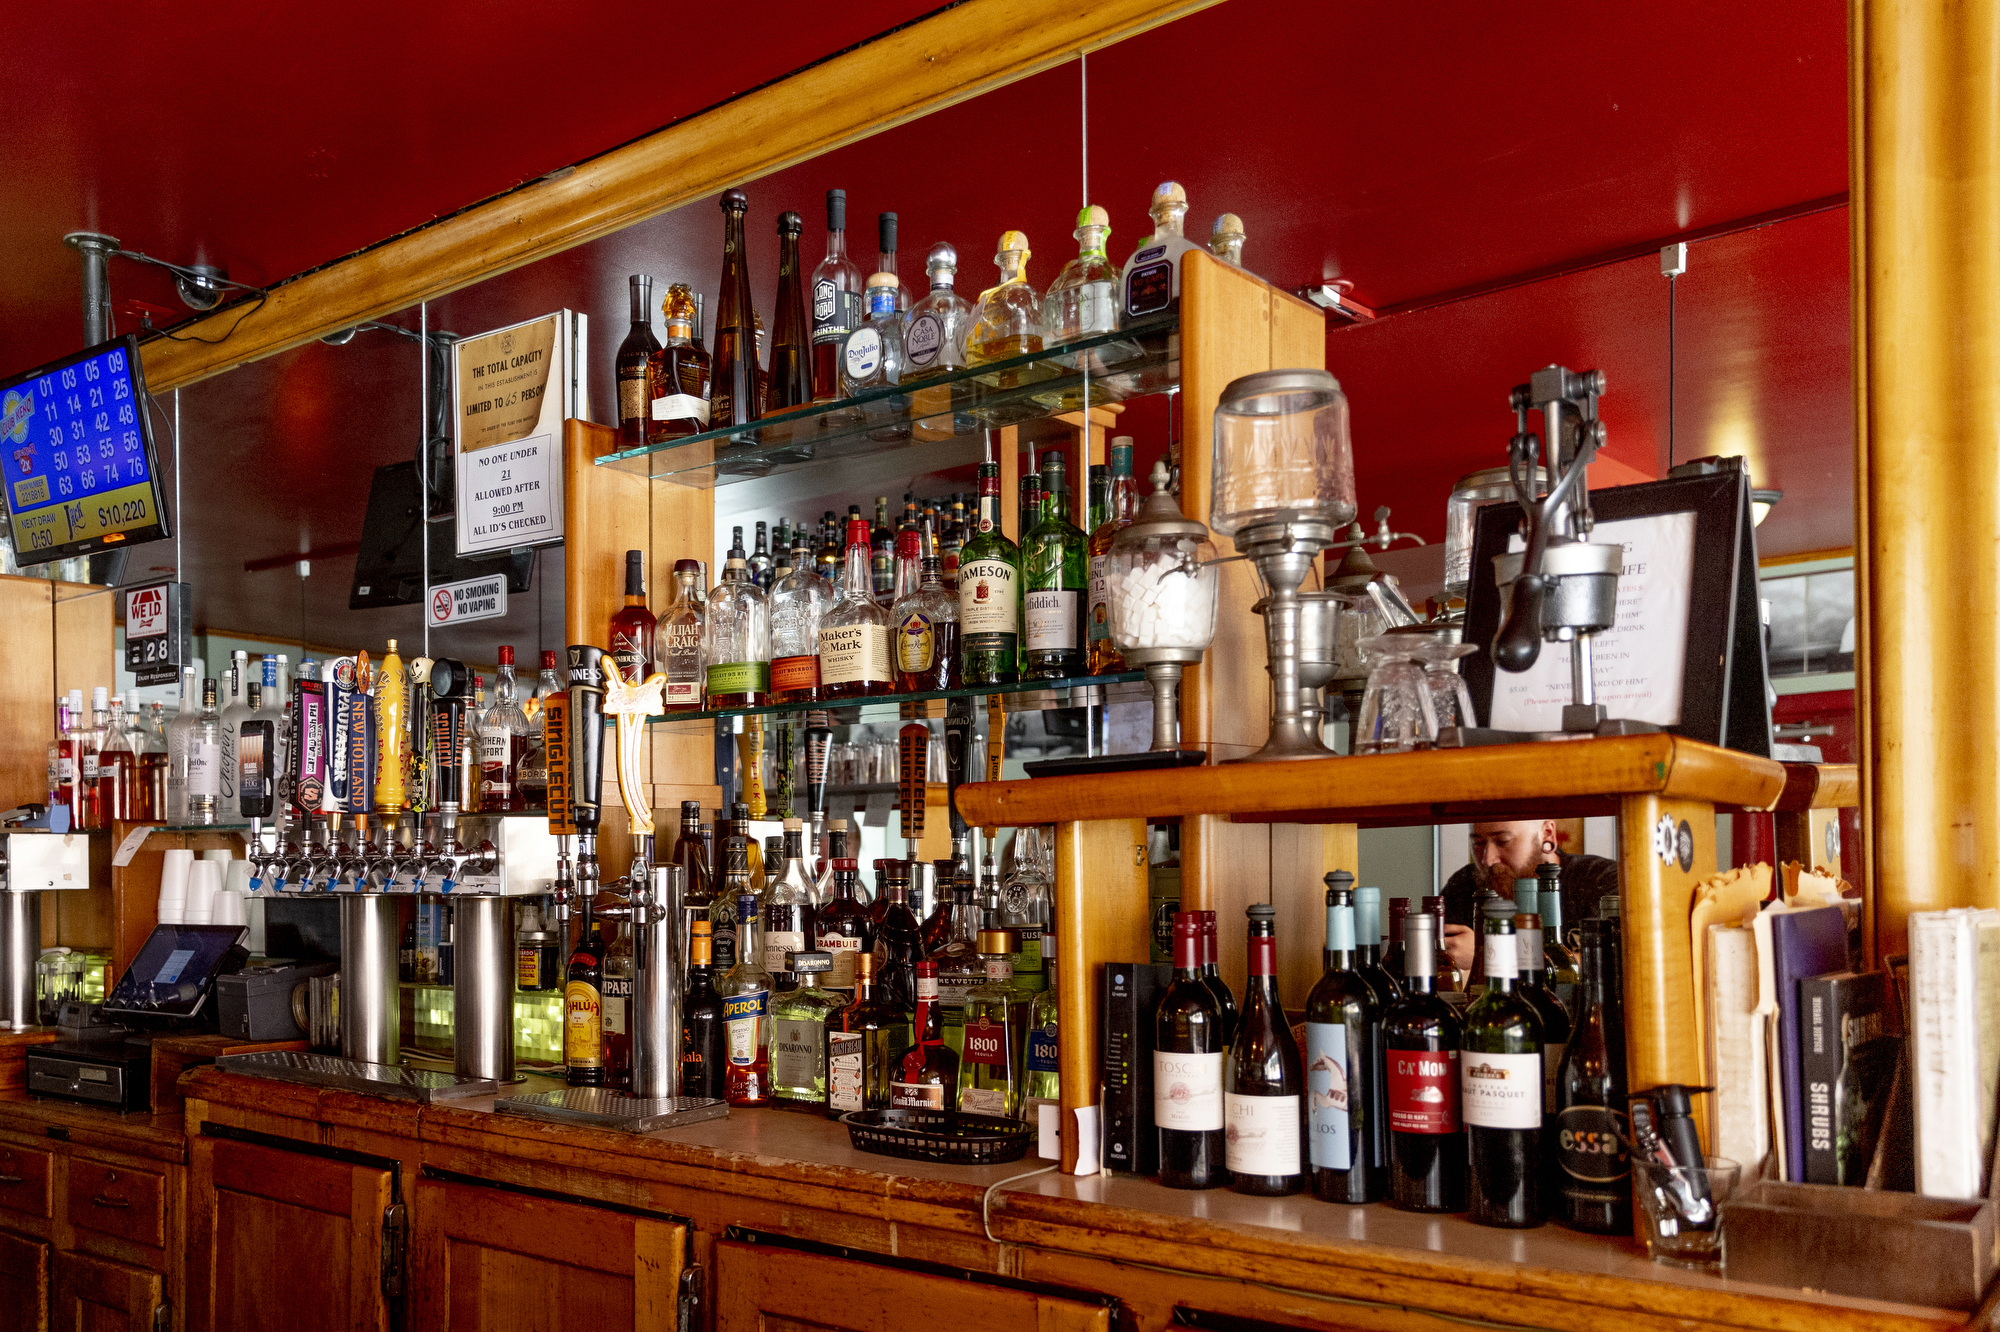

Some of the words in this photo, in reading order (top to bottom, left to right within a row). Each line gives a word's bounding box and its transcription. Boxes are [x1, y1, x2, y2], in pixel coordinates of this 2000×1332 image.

[912, 332, 935, 346] NOBLE
[913, 326, 933, 338] CASA
[473, 366, 485, 379] THE
[487, 360, 508, 375] TOTAL
[511, 349, 543, 368] CAPACITY
[39, 376, 53, 398] 01
[62, 368, 77, 390] 03
[84, 359, 100, 382] 05
[108, 351, 124, 374] 09
[497, 371, 533, 386] ESTABLISHMENT
[44, 401, 58, 422] 11
[67, 393, 82, 415] 14
[89, 386, 104, 408] 21
[113, 378, 129, 400] 25
[466, 400, 492, 416] LIMITED
[494, 397, 503, 409] TO
[505, 391, 518, 407] 65
[1, 416, 16, 436] CLUB
[15, 398, 31, 421] KENO
[49, 426, 64, 447] 30
[71, 419, 85, 441] 31
[95, 411, 111, 433] 42
[118, 404, 134, 426] 48
[54, 451, 69, 472] 50
[76, 444, 91, 466] 53
[99, 437, 115, 460] 55
[123, 430, 139, 453] 56
[478, 456, 490, 468] NO
[491, 452, 508, 466] ONE
[509, 446, 538, 462] UNDER
[58, 475, 73, 497] 63
[80, 469, 96, 491] 66
[103, 463, 119, 484] 74
[127, 456, 144, 478] 76
[501, 470, 512, 481] 21
[474, 485, 513, 502] ALLOWED
[514, 480, 540, 496] AFTER
[98, 499, 146, 528] $10,220
[492, 503, 511, 516] 9:00
[512, 501, 524, 513] PM
[21, 518, 37, 529] NEXT
[38, 513, 56, 526] DRAW
[473, 525, 488, 536] ALL
[489, 520, 507, 534] ID'S
[508, 514, 547, 531] CHECKED
[31, 529, 53, 549] 0:50
[960, 565, 1011, 585] JAMESON
[454, 588, 464, 602] NO
[465, 582, 499, 600] SMOKING
[1095, 580, 1104, 591] 12
[131, 604, 146, 620] WE
[149, 601, 162, 617] I.D.
[458, 603, 468, 615] NO
[469, 598, 496, 613] VAPING
[666, 624, 699, 636] ELIJAH
[820, 628, 862, 643] Maker's
[1616, 623, 1645, 633] DRINK
[666, 635, 698, 649] CRAIG
[830, 640, 862, 653] Mark
[901, 640, 913, 651] Crown
[913, 639, 930, 650] Royal
[827, 655, 855, 663] WHISKY
[1595, 652, 1618, 661] BEEN
[1619, 651, 1630, 660] IN
[150, 672, 176, 680] RESPONSIBLY
[352, 701, 365, 732] NEW
[432, 712, 452, 768] SCHLAFLY
[219, 722, 235, 798] Chopin
[546, 707, 565, 828] SINGLECUT
[352, 736, 365, 807] HOLLAND
[245, 778, 258, 788] FOG
[1111, 991, 1128, 999] U-verse
[723, 999, 763, 1018] APEROL
[778, 1042, 812, 1054] DISARONNO
[969, 1036, 998, 1052] 1800
[1397, 1060, 1416, 1076] CA'
[907, 1096, 937, 1108] Marnier
[1480, 1089, 1525, 1098] PASQUET
[1810, 1082, 1831, 1150] SHRUBS
